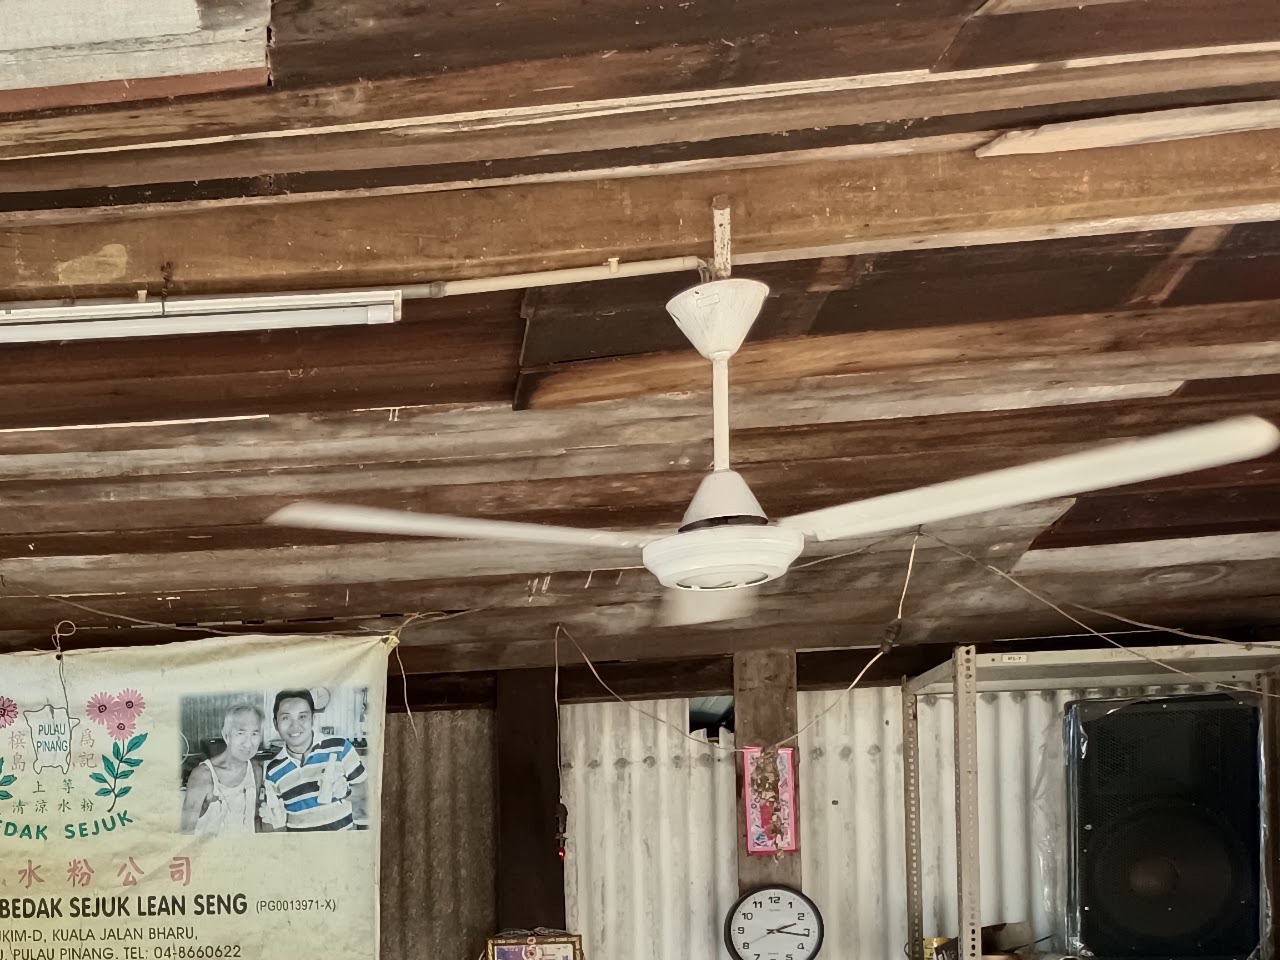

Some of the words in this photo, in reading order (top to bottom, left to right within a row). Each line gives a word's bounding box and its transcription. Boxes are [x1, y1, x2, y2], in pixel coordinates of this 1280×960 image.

[38, 723, 66, 736] PULAU
[36, 740, 68, 752] PINANG
[64, 810, 134, 840] SEJUK
[768, 896, 780, 904] 12
[0, 897, 63, 919] BEDAK
[70, 895, 130, 918] SEJUK
[137, 894, 186, 917] LEAN
[193, 893, 248, 915] SENG
[256, 899, 336, 914] (PG0013971-X)
[752, 901, 763, 909] 11
[787, 901, 793, 909] 1
[741, 912, 753, 920] 10
[797, 912, 805, 921] 2
[52, 928, 96, 942] KUALA
[100, 927, 143, 940] JALAN
[149, 926, 198, 941] BHARU,
[737, 926, 745, 934] 9
[742, 942, 750, 950] 8
[797, 942, 805, 950] 4
[14, 948, 55, 960] PULAU
[60, 947, 119, 960] PINANG.
[123, 947, 149, 960] TEL:
[154, 945, 242, 959] 04-8660622
[753, 953, 761, 960] 7
